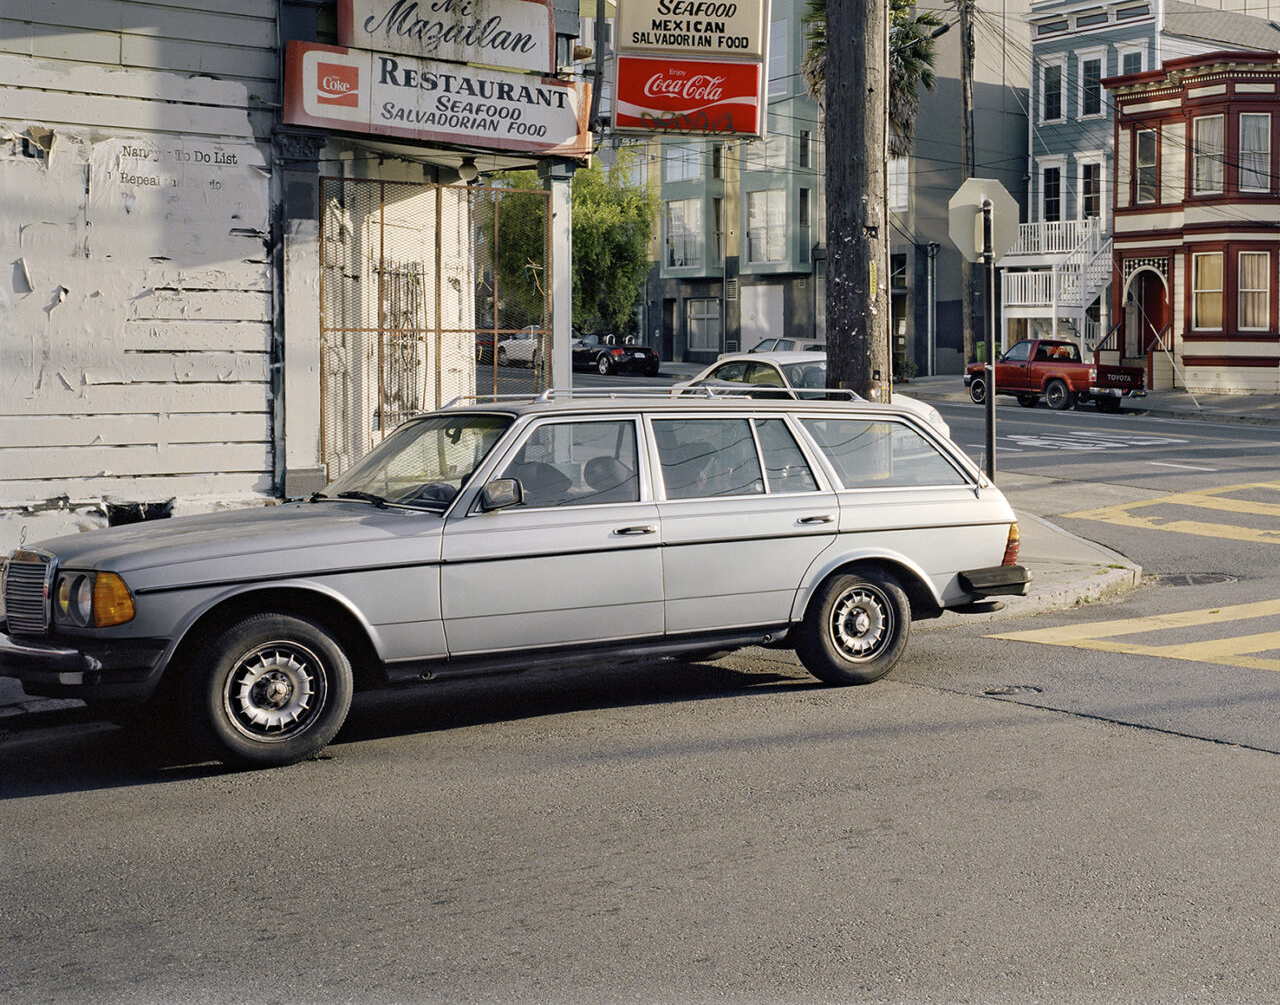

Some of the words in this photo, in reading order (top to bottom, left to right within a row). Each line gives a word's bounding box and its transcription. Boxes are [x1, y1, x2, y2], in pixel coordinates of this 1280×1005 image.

[651, 19, 725, 33] MEXICAN
[632, 32, 712, 47] SALVADORIAN
[718, 36, 749, 49] FOOD
[669, 68, 686, 77] Enjoy
[323, 76, 350, 91] Coke
[378, 56, 570, 109] RESTAURANT
[644, 72, 727, 100] Coca-Cola
[435, 95, 521, 121] SEAFOOD
[381, 102, 500, 132] SALVADORIAN
[506, 121, 547, 138] FOOD
[194, 150, 211, 163] Do
[214, 152, 238, 165] List
[1107, 373, 1131, 381] TOYOTA
